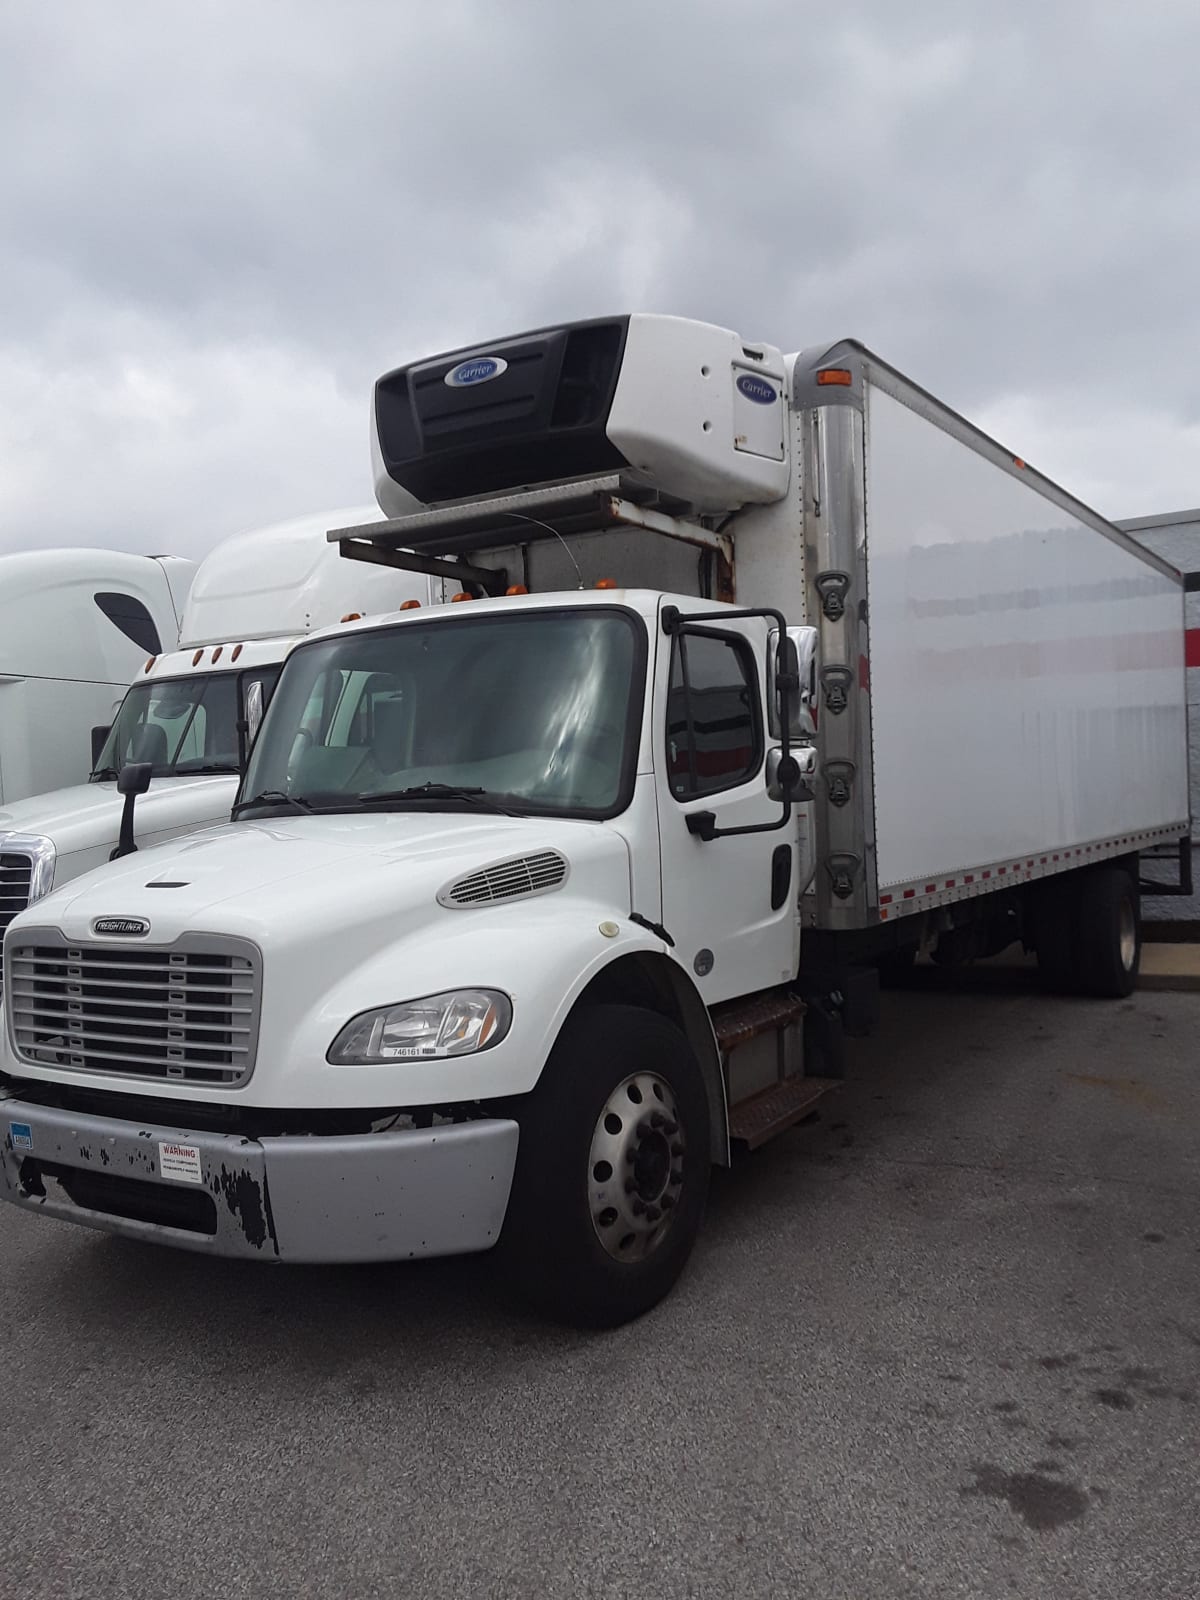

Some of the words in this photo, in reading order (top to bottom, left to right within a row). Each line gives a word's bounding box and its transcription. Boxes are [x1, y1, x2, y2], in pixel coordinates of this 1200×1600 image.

[458, 364, 492, 380] Carrier
[742, 379, 772, 398] Carrier
[96, 921, 143, 931] FREIGHTLINER
[392, 1048, 420, 1056] 746161
[163, 1145, 196, 1158] WARNING
